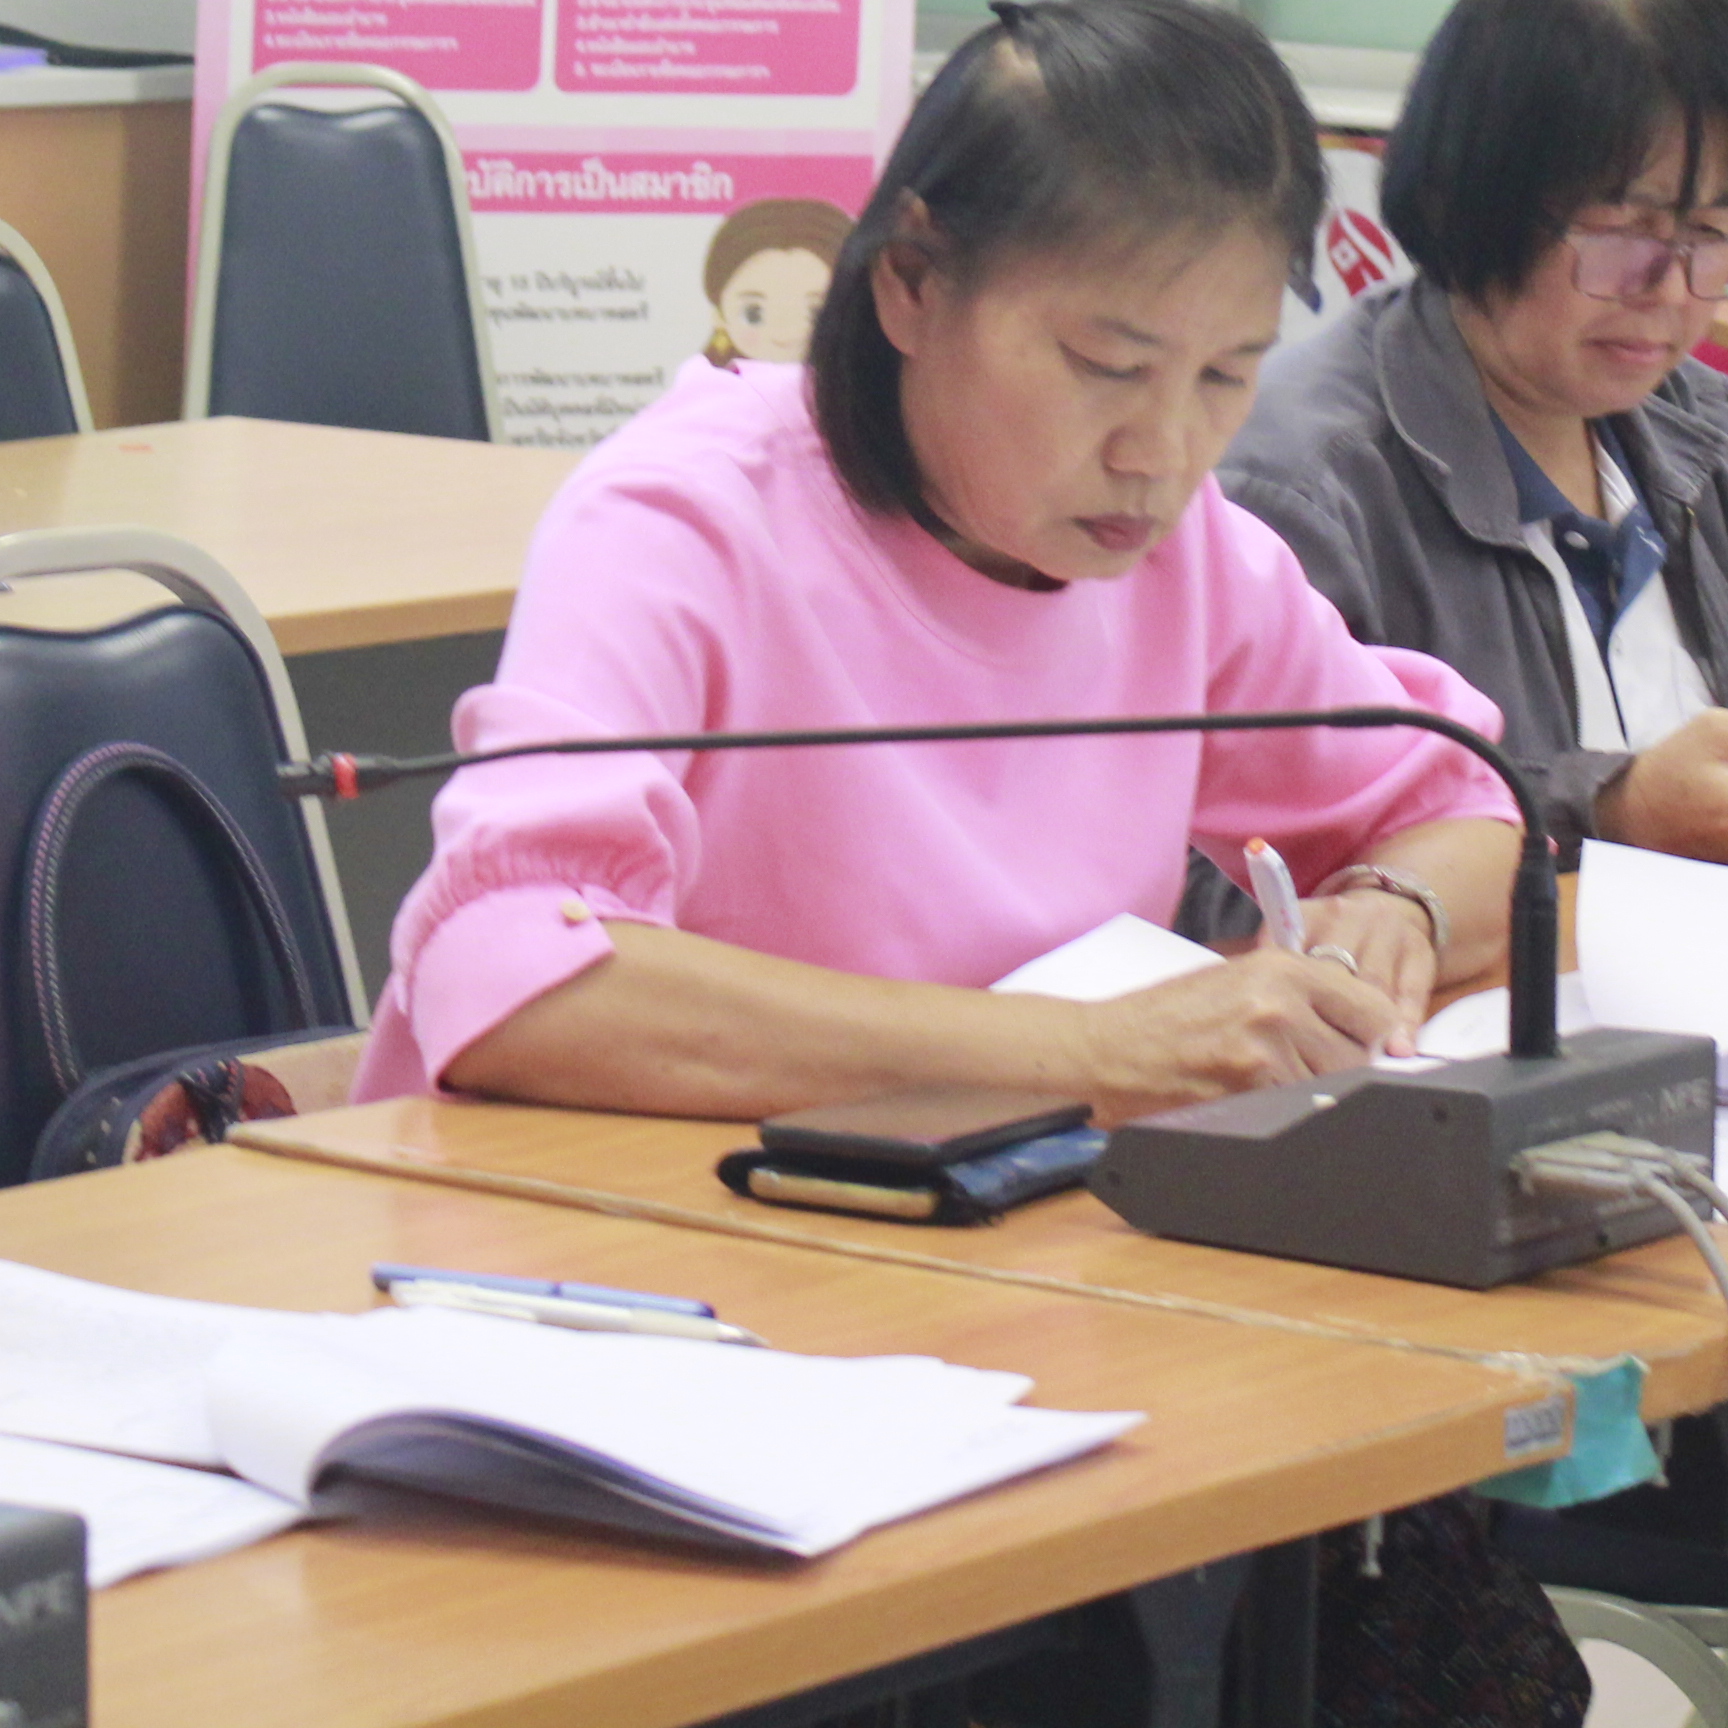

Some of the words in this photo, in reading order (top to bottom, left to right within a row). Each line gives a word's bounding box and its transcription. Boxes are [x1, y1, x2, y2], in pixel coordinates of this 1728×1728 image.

[467, 155, 735, 201] บัติการเป็นสมาชิก
